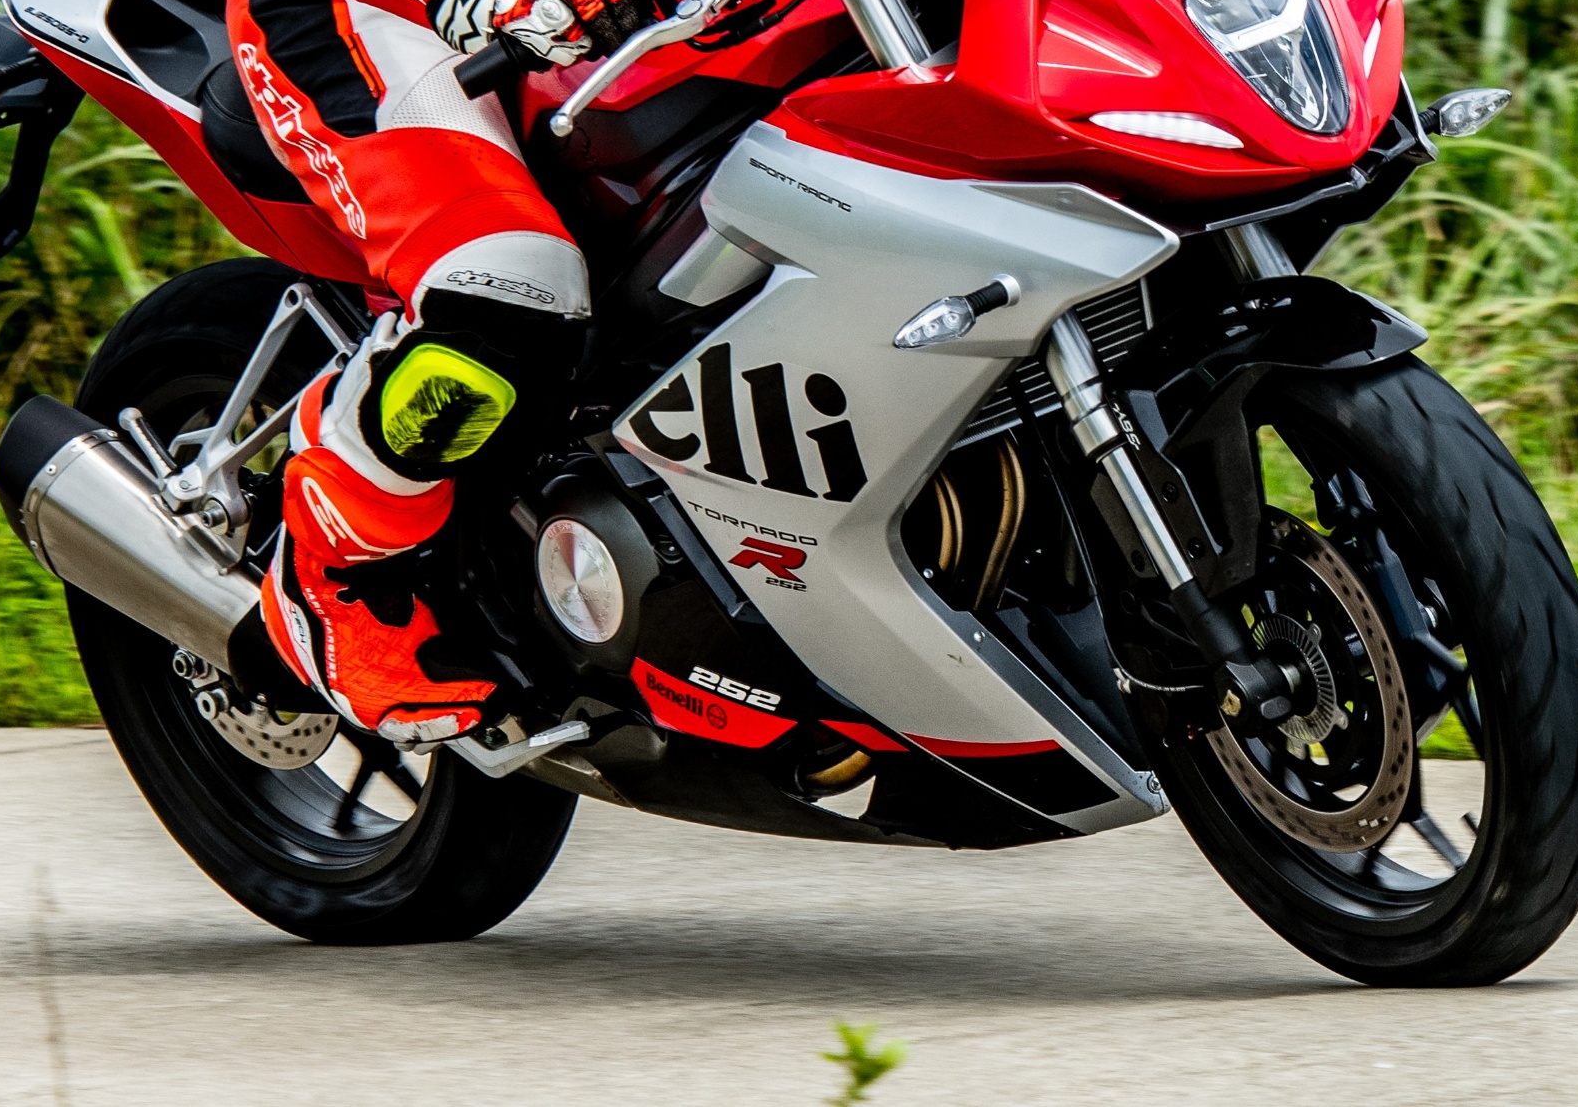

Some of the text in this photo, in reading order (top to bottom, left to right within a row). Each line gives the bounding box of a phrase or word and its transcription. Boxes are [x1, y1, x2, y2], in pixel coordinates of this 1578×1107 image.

[749, 157, 852, 213] SPORT RACING
[446, 270, 555, 304] alpinestars
[627, 341, 869, 503] elli
[687, 500, 818, 546] TORNADO
[727, 536, 808, 584] R
[765, 576, 807, 593] 252
[646, 672, 704, 717] Benelli
[688, 666, 782, 711] 252
